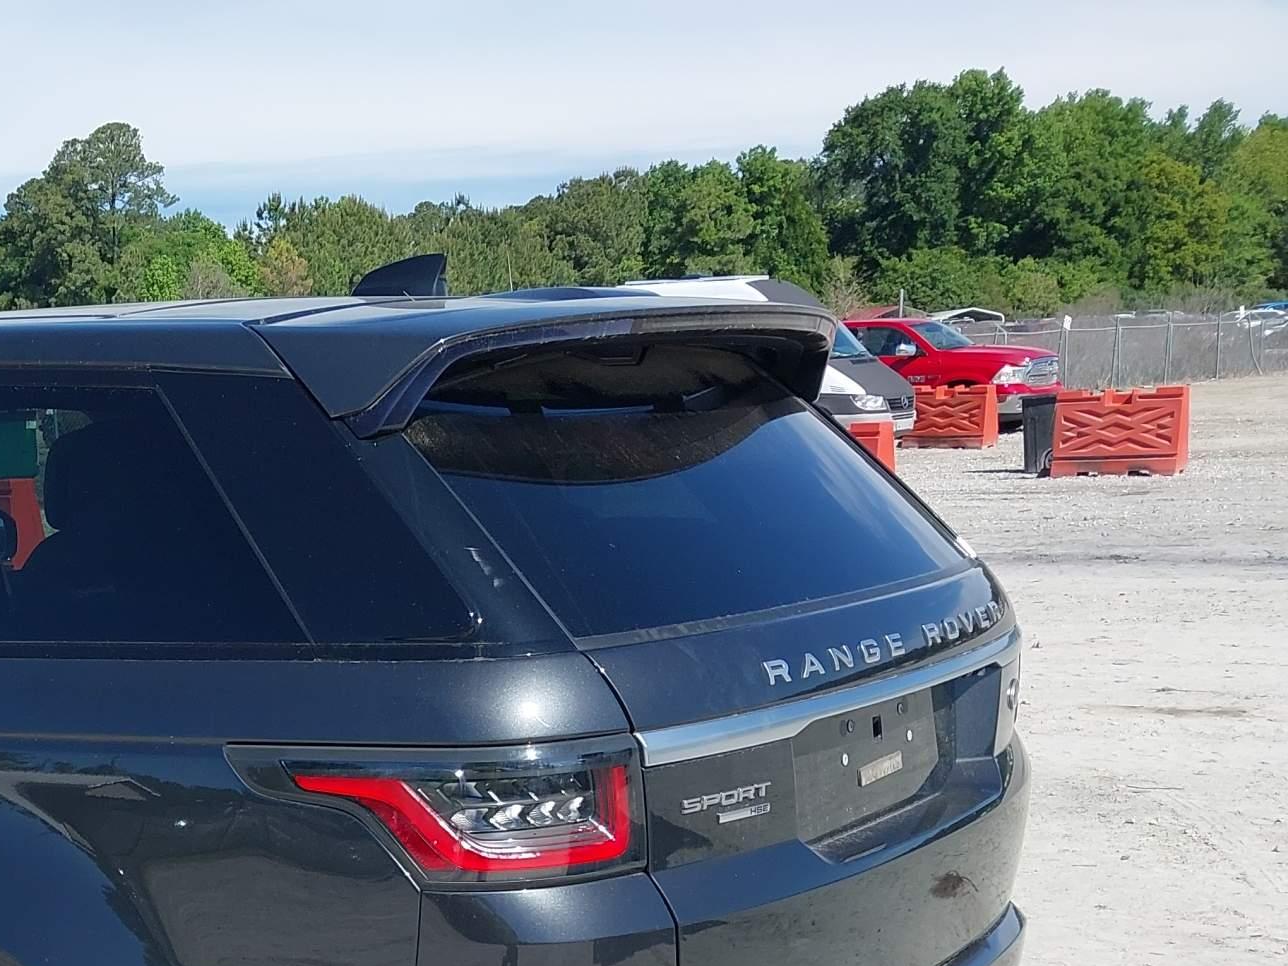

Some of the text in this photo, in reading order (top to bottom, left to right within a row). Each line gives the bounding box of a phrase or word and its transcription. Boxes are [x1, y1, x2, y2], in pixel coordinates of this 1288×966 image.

[761, 600, 1004, 686] RANGE ROVER
[681, 781, 772, 815] SPORT
